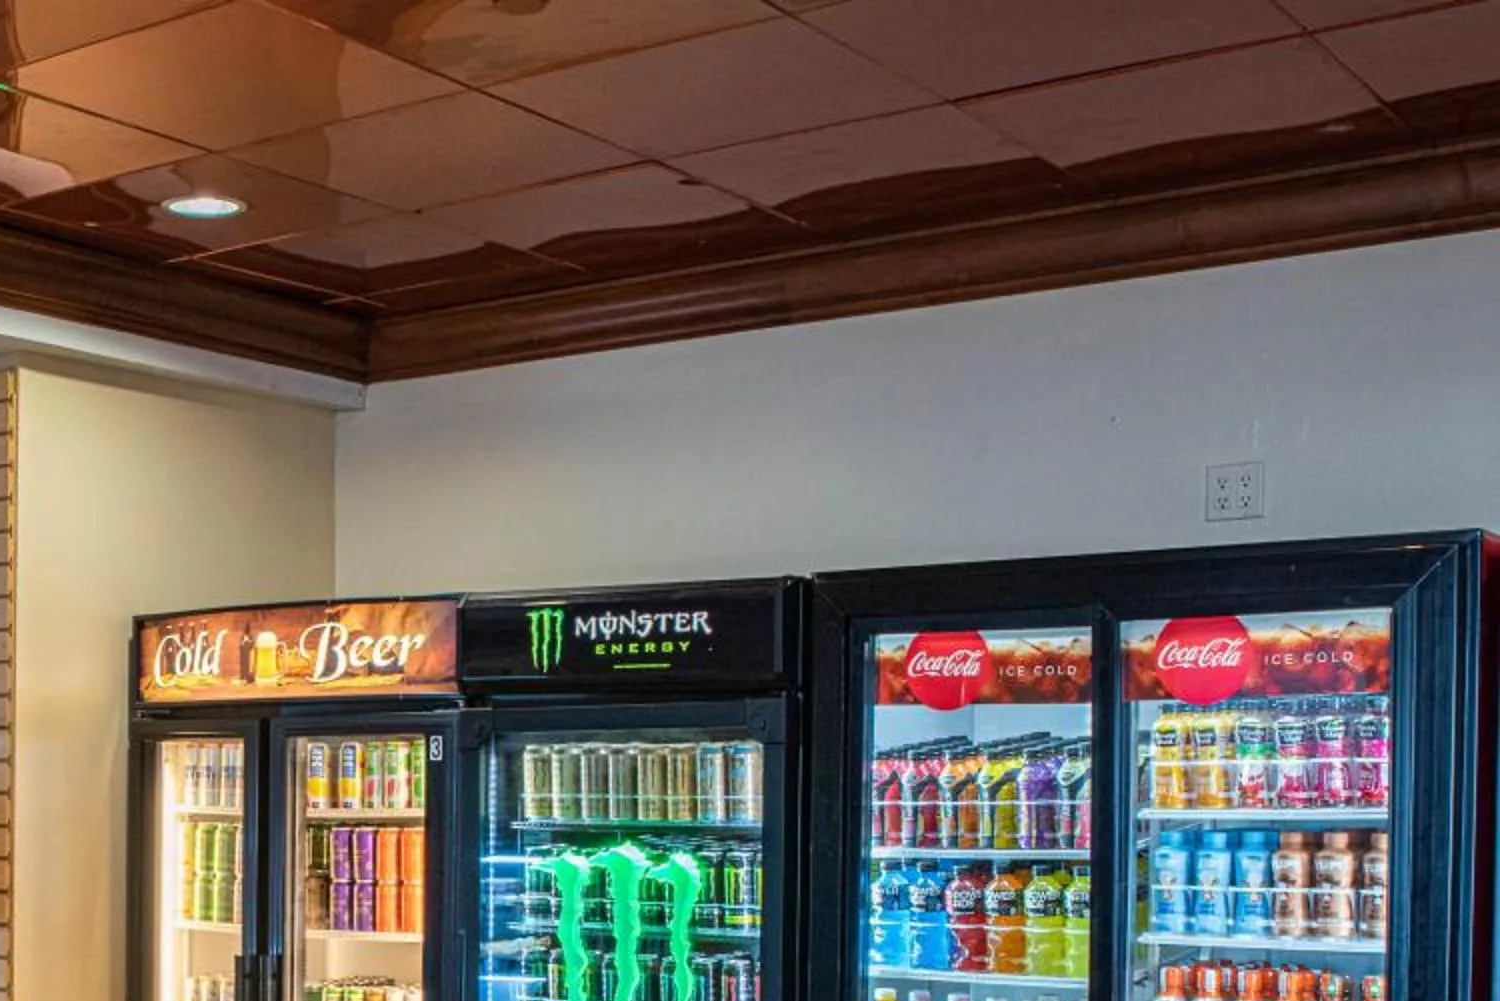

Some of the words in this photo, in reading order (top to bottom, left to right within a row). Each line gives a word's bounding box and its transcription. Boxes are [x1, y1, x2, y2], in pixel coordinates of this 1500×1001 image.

[574, 609, 712, 640] MONSTER
[153, 628, 229, 688] Cold
[300, 620, 426, 684] Beer
[595, 640, 691, 655] ENERGY
[1157, 636, 1247, 670] Coca-Cola
[1264, 653, 1294, 666] ICE
[1303, 650, 1354, 664] COLD
[907, 648, 986, 679] Coca-Cola
[999, 665, 1026, 678] ICE
[1033, 664, 1078, 677] COLD
[431, 737, 441, 759] 3
